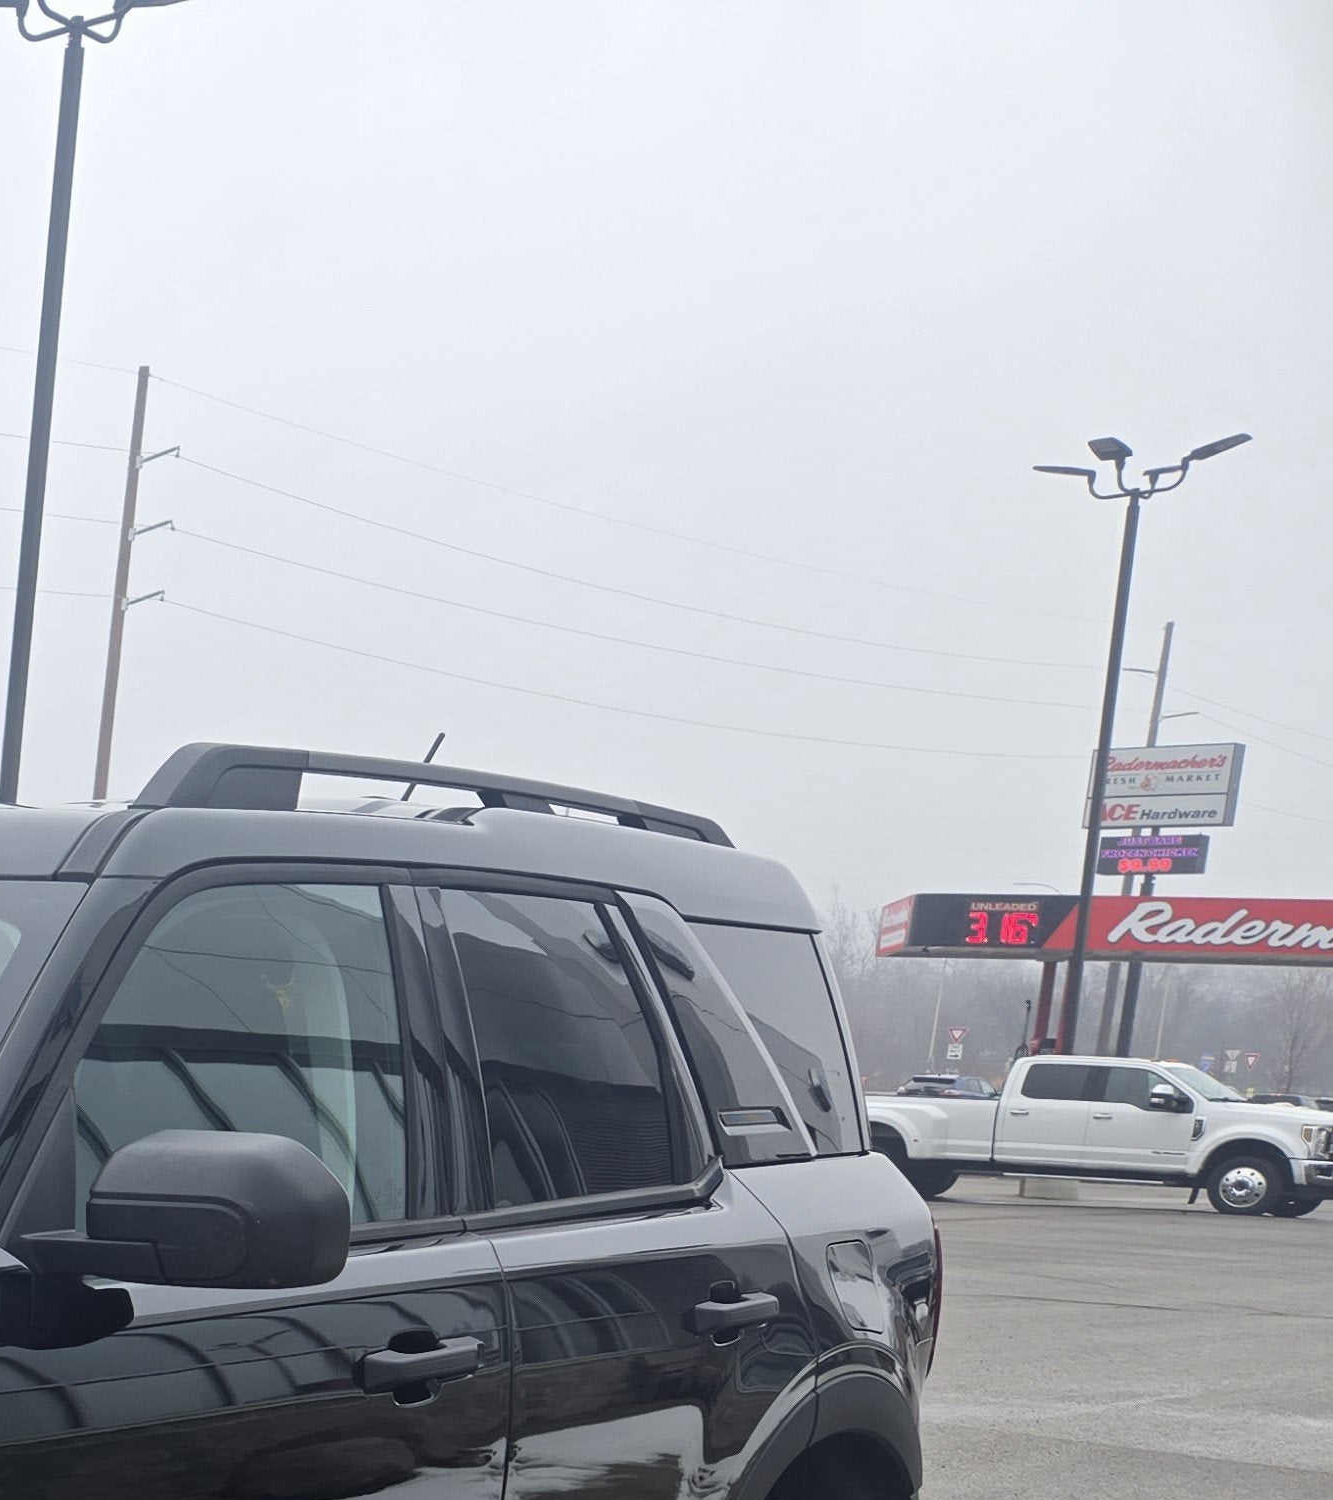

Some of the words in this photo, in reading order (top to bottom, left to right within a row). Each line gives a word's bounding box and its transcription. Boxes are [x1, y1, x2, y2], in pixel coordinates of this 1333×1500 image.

[1106, 776, 1136, 785] RESH
[1164, 774, 1220, 783] MARKET
[1139, 808, 1218, 820] Hardware
[970, 902, 1039, 911] UNLEADED
